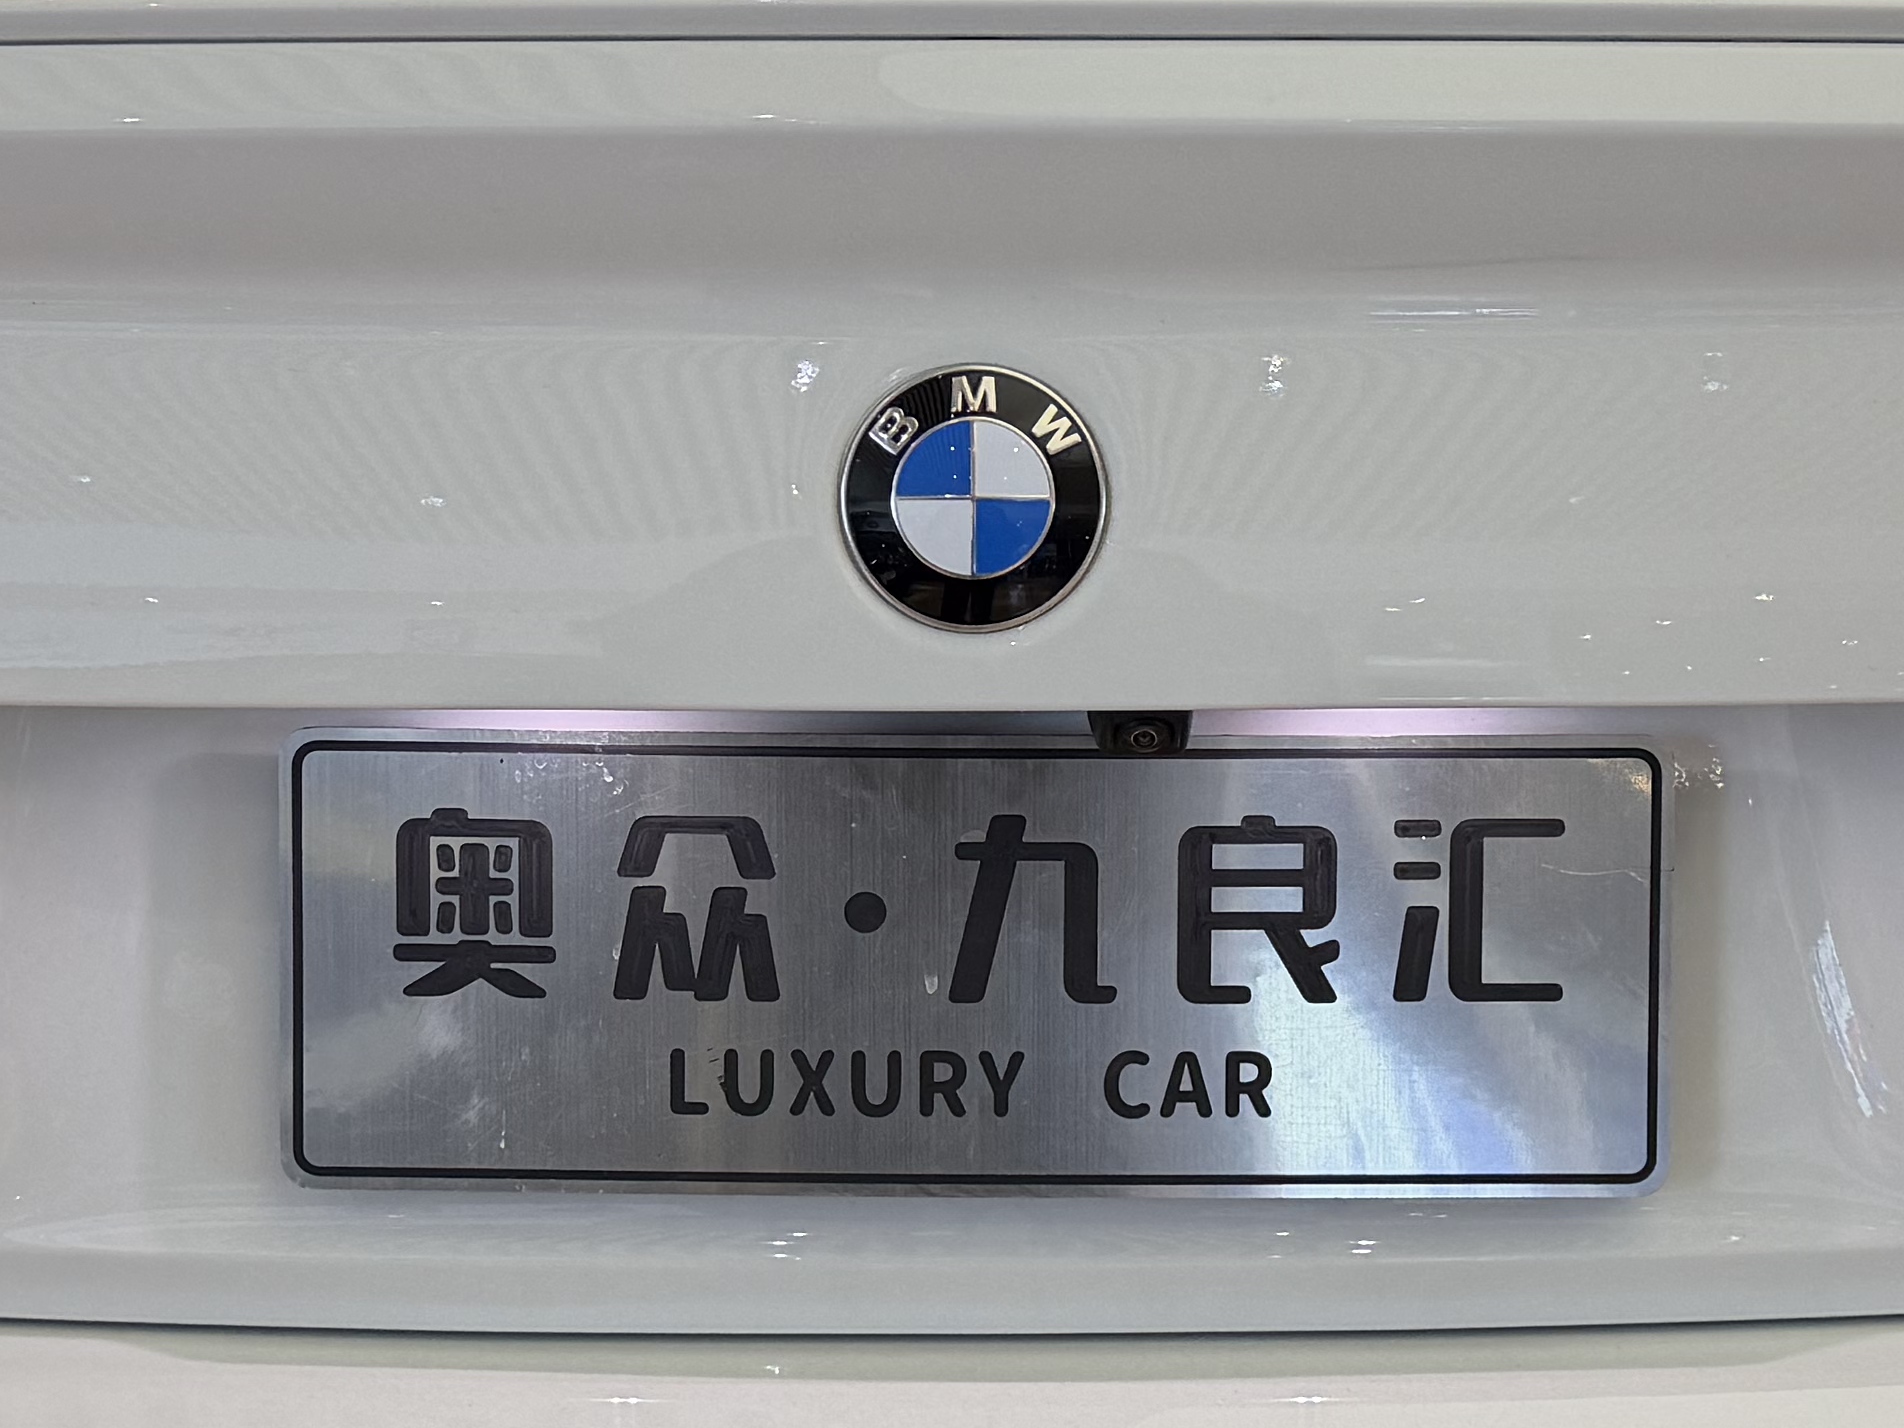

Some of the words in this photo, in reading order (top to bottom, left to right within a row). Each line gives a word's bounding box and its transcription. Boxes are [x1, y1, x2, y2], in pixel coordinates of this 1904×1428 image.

[868, 375, 1082, 456] BMW
[393, 807, 1565, 1005] 奥众·九良汇
[669, 1048, 1024, 1119] LUXURY
[1103, 1048, 1275, 1119] CAR
